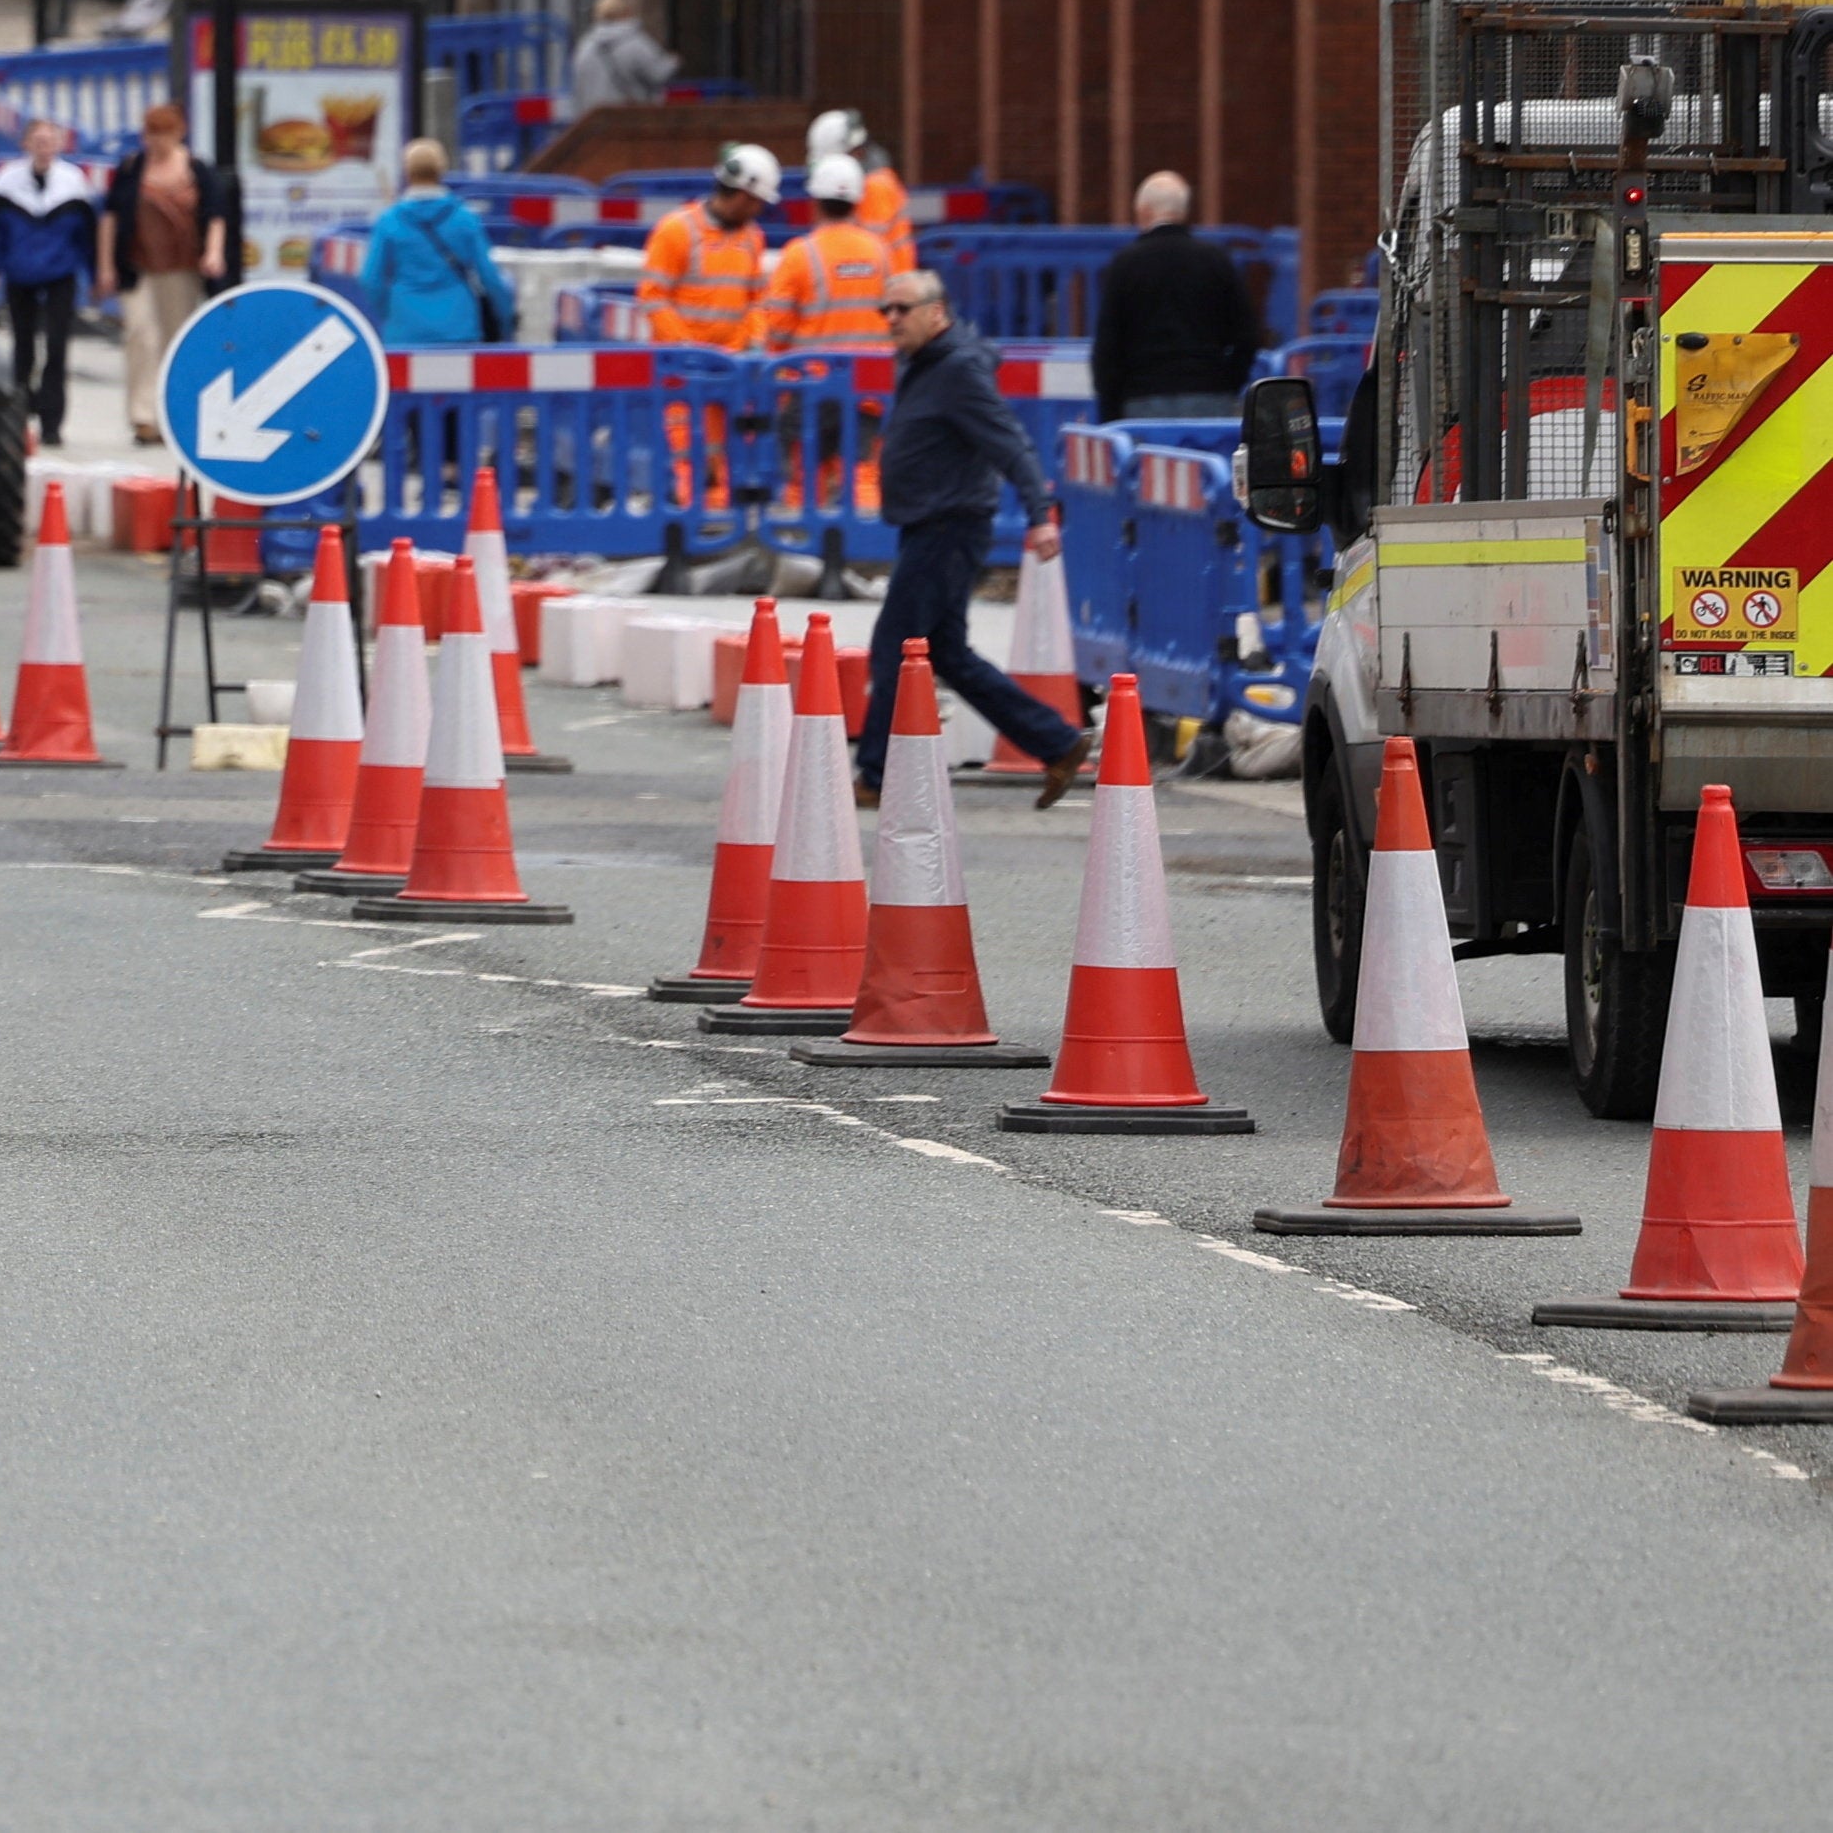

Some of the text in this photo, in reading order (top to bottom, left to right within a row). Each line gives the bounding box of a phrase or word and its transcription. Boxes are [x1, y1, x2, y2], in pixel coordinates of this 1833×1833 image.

[1682, 570, 1791, 589] WARNING
[1676, 630, 1796, 640] DO NOT PASS ON THE INSIDE
[1700, 656, 1724, 673] DEL
